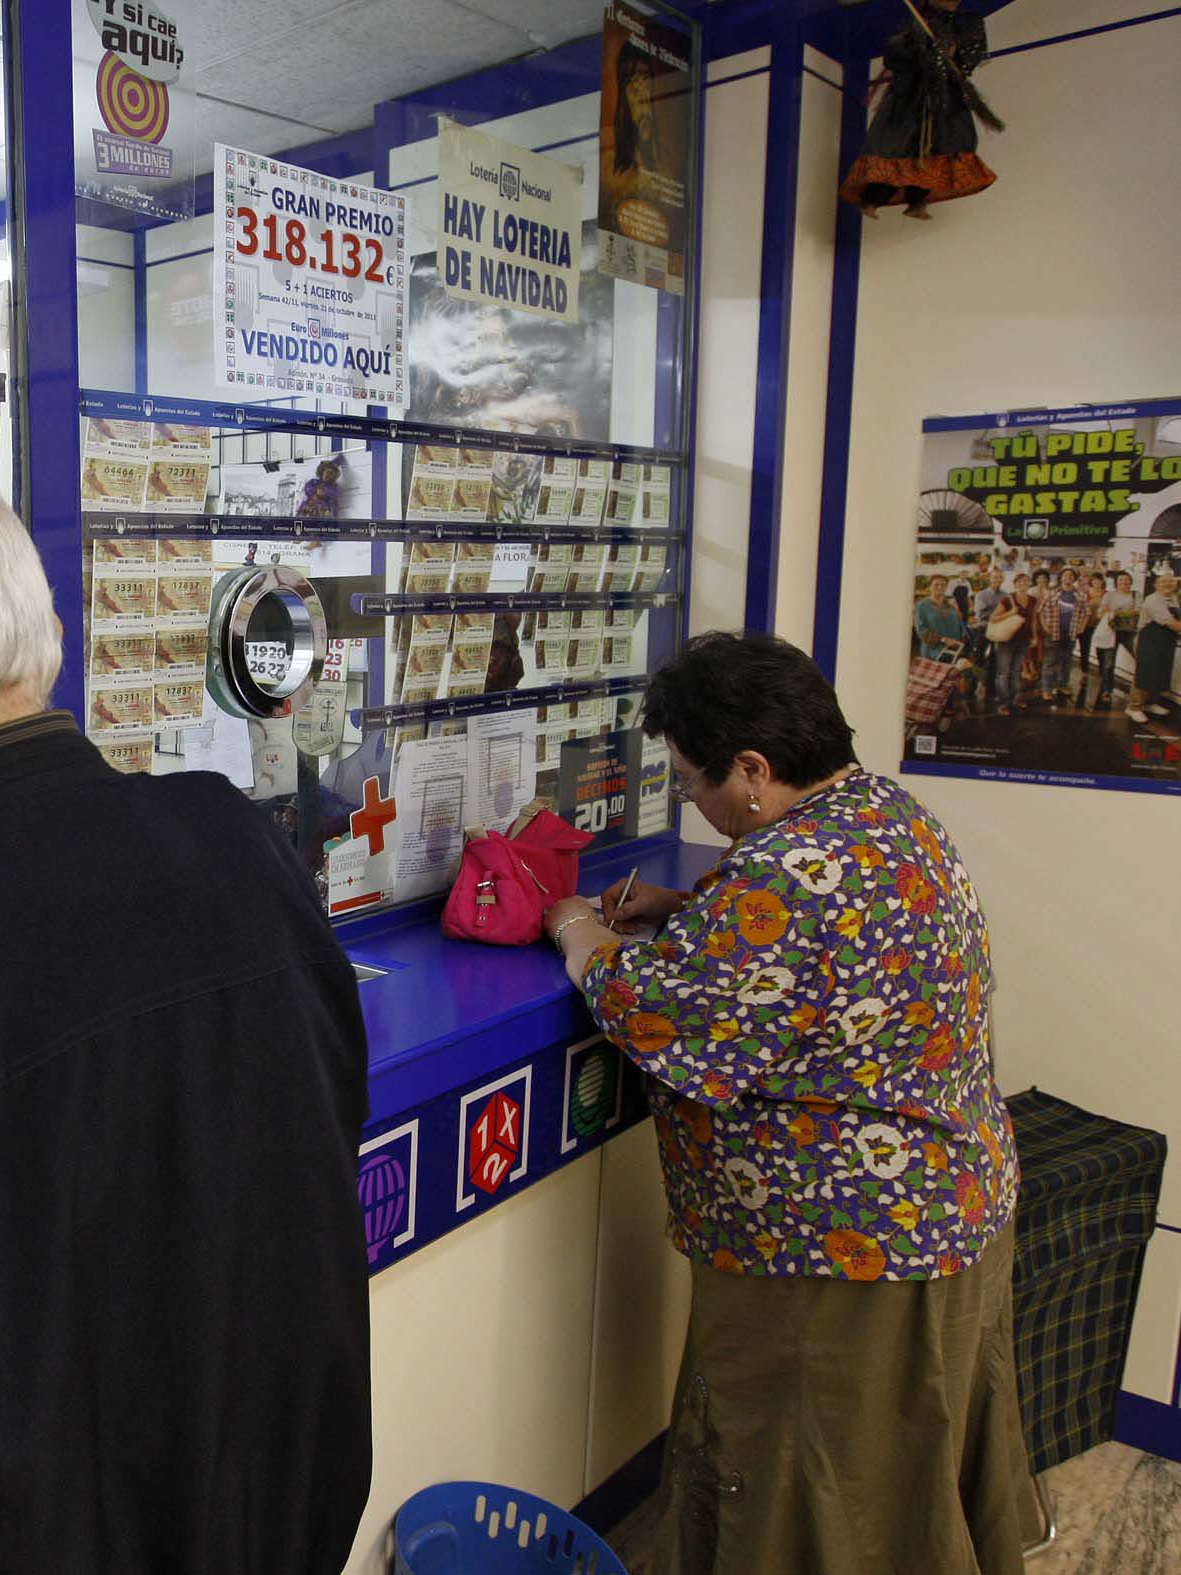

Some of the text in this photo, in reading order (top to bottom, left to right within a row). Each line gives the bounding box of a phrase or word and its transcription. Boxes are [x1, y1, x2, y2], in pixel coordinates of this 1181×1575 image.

[123, 2, 177, 39] si cae
[101, 20, 184, 70] aquí?
[97, 142, 110, 168] 3
[110, 145, 170, 169] MILLONES
[470, 161, 552, 202] Lotería Nacional
[271, 187, 319, 220] GRAN
[326, 201, 394, 236] PREMIO
[444, 192, 486, 244] HAY
[493, 209, 572, 269] LOTERIA
[285, 279, 353, 303] 5 1 ACIERTOS
[445, 246, 472, 291] DE
[480, 255, 568, 315] NAVIDAD
[258, 291, 280, 304] Semana
[291, 322, 349, 340] Euro Millones
[241, 329, 391, 378] VENDIDO AQUÍ
[1056, 411, 1093, 421] Apuestas
[1108, 406, 1137, 416] Estado
[990, 429, 1146, 460] TÚ PIDE,
[948, 455, 1181, 493] QUE NO TE LO
[984, 488, 1141, 516] GASTAS.
[1007, 523, 1110, 538] La Primitiva
[115, 583, 143, 592] 33311
[252, 645, 286, 659] 19 20
[325, 653, 342, 666] 23
[250, 661, 266, 673] 26
[324, 669, 340, 681] 30
[113, 693, 139, 703] 33311
[110, 747, 139, 757] 33311
[477, 1115, 488, 1152] 1
[499, 1102, 517, 1145] X
[483, 1152, 508, 1185] 2
